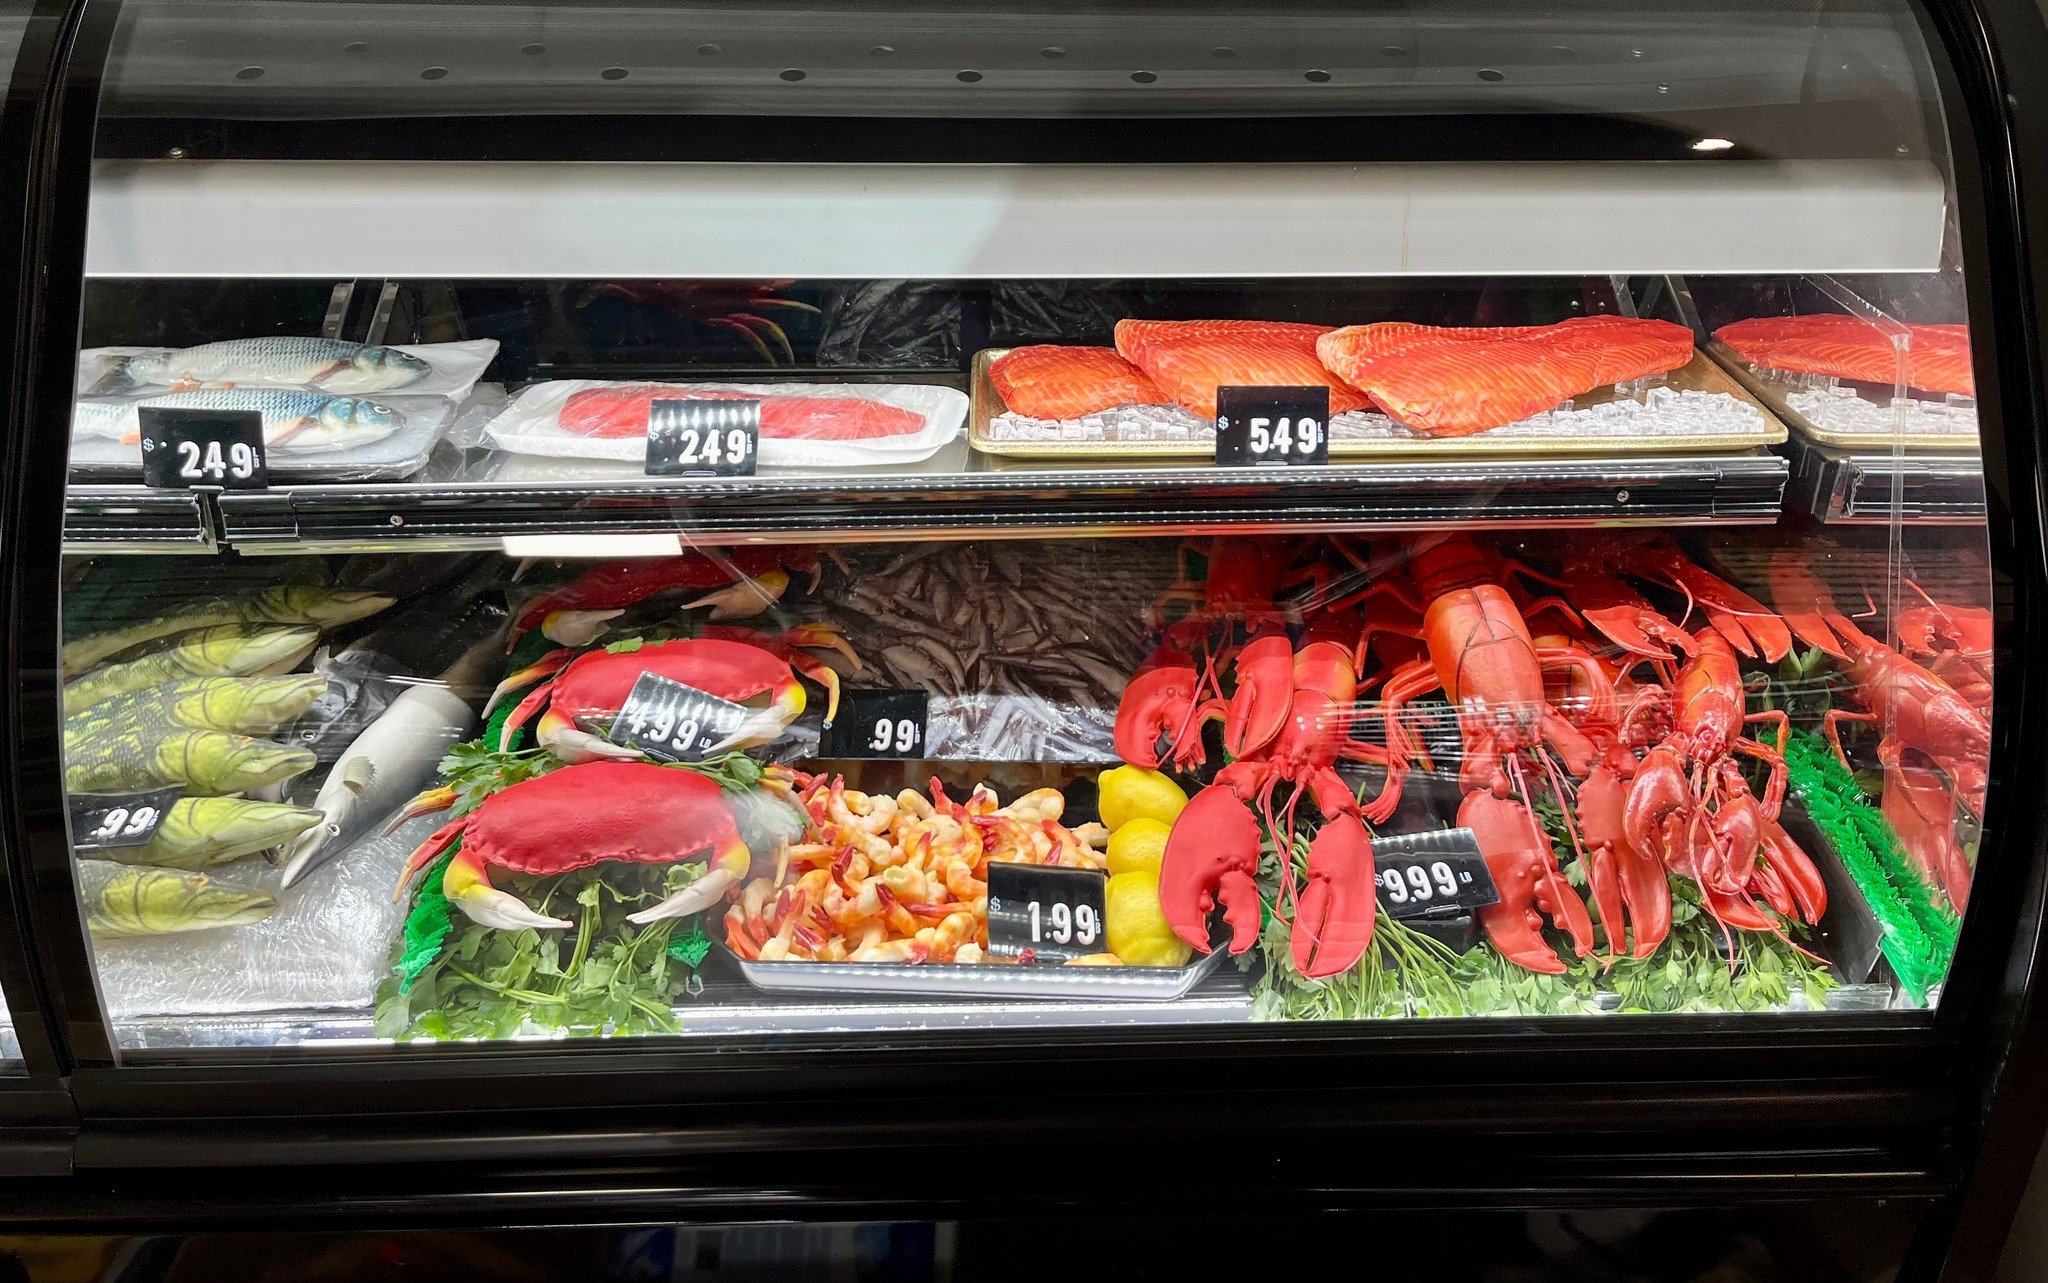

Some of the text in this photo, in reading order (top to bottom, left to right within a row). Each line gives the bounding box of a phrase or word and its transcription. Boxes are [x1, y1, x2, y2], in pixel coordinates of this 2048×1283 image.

[678, 429, 746, 465] 2.49
[1218, 415, 1229, 431] $
[1250, 417, 1318, 454] 5.49
[143, 437, 155, 452] $
[178, 440, 253, 479] 2.49
[627, 701, 699, 751] 4.99
[869, 718, 915, 753] .99
[90, 806, 155, 837] .99
[1459, 871, 1473, 883] LB
[990, 896, 1001, 912] $
[1028, 901, 1096, 946] 1.99
